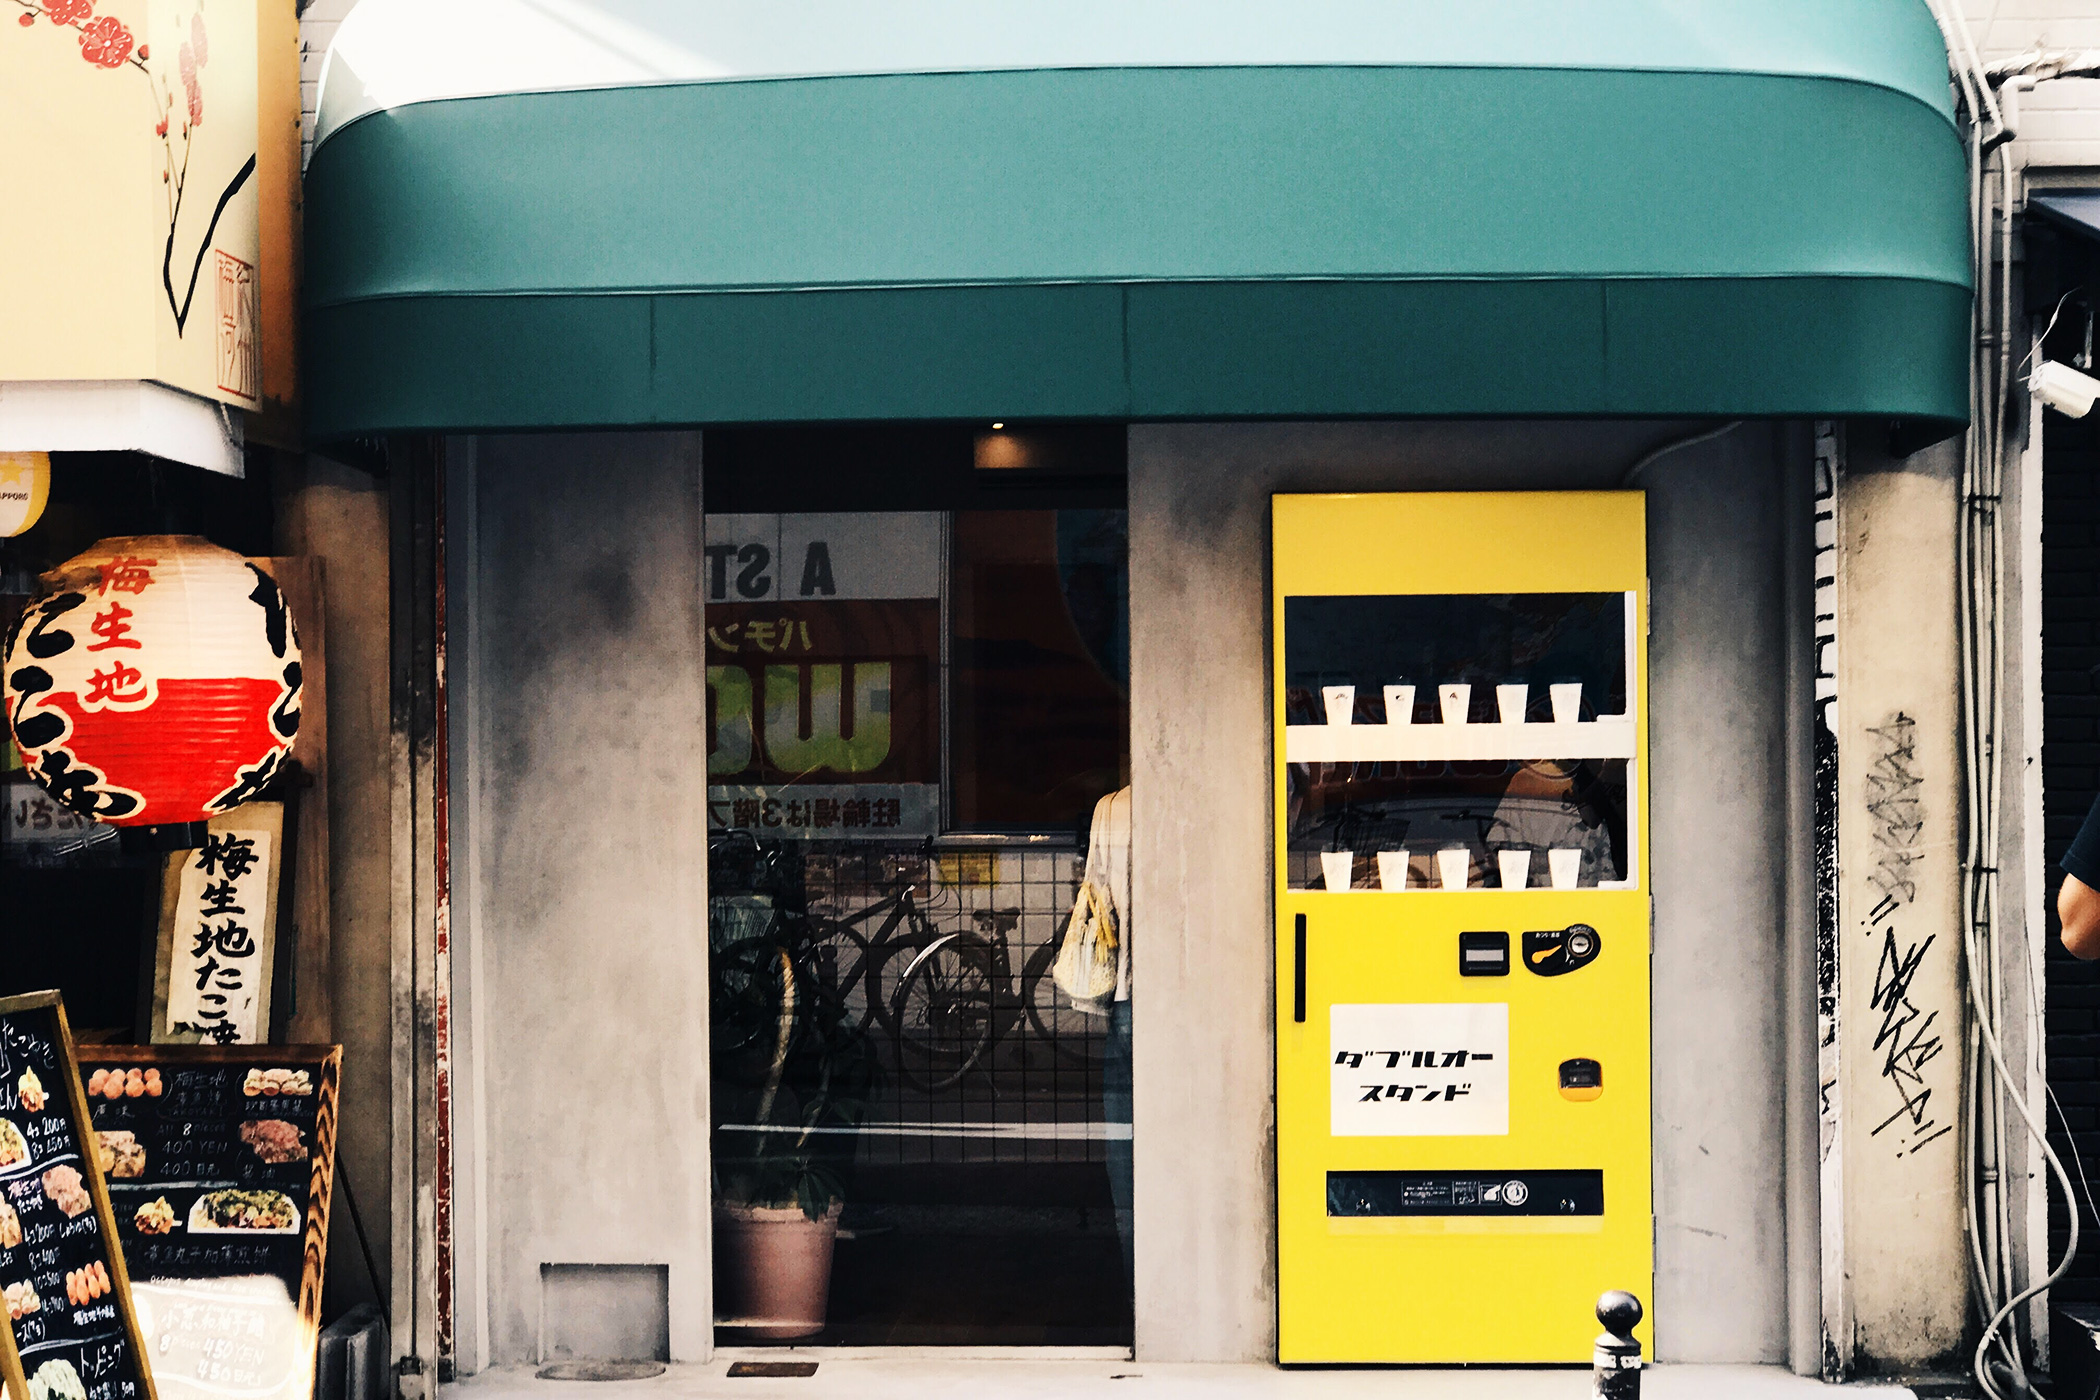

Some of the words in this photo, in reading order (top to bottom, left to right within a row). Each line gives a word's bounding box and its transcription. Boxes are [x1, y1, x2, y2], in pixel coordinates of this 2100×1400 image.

[86, 556, 157, 704] 梅生地
[1335, 1050, 1494, 1069] ダブルオー
[1359, 1083, 1472, 1102] スタンド
[182, 1122, 193, 1136] 8
[161, 1140, 193, 1154] 400
[199, 1141, 228, 1154] YEN
[160, 1160, 190, 1176] 400
